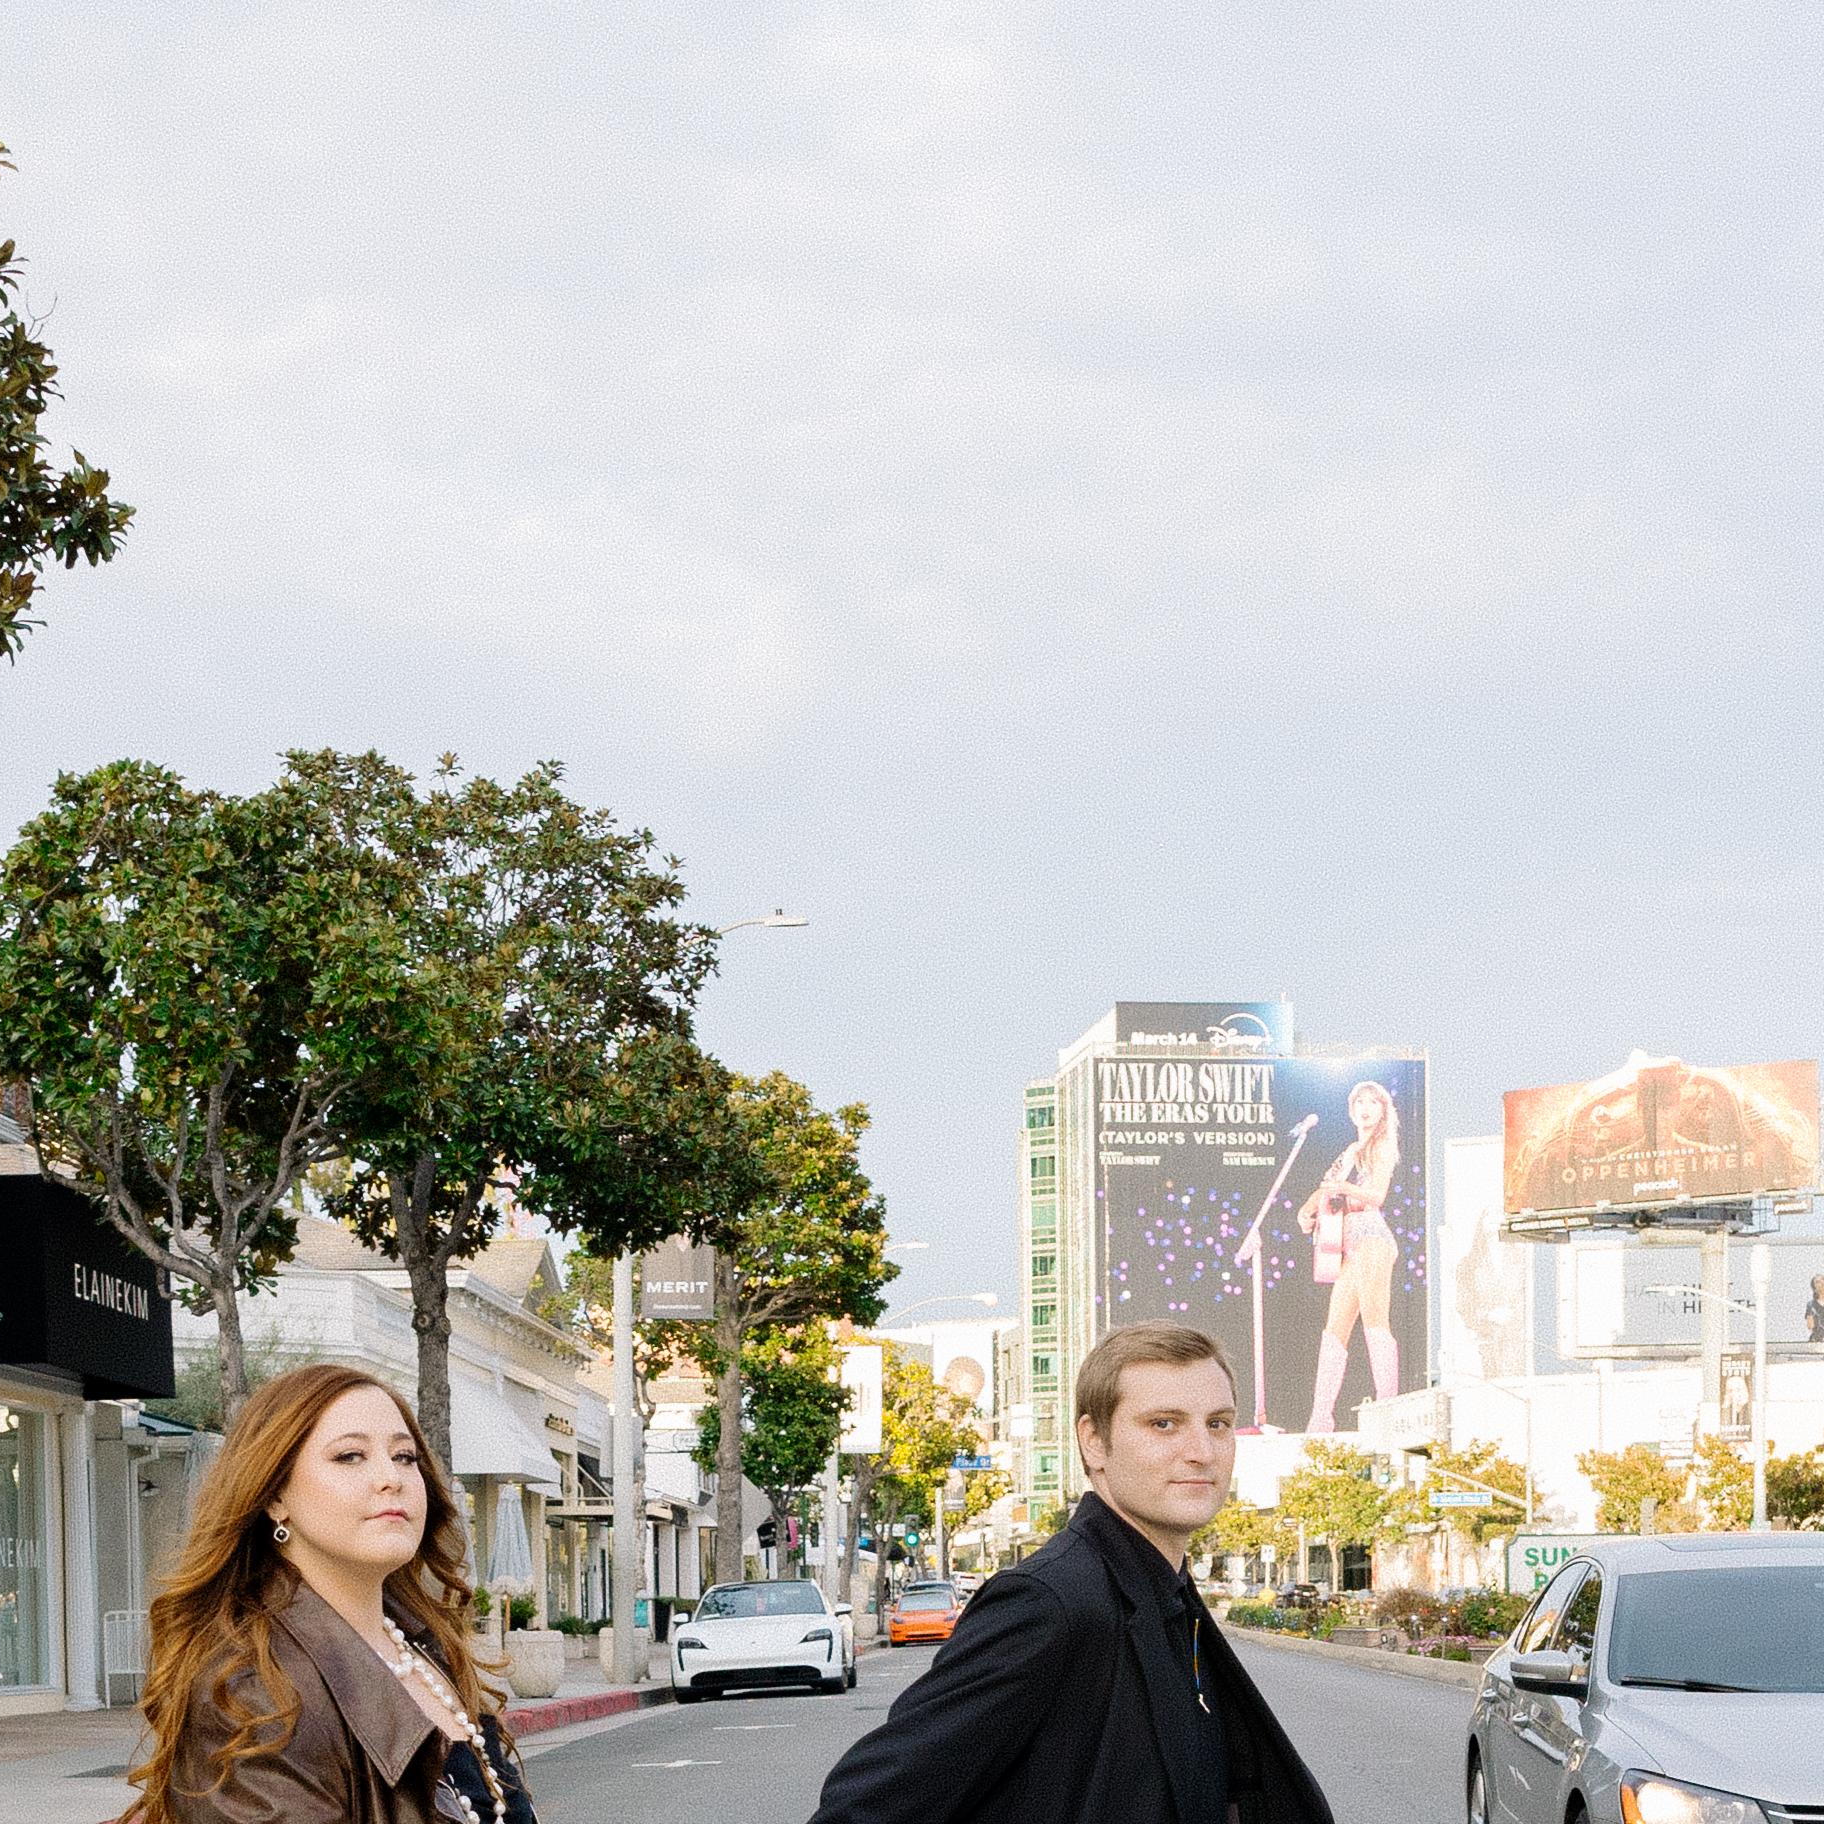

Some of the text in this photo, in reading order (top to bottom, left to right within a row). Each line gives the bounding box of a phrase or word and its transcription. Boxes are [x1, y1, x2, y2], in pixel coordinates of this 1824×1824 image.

[1130, 1031, 1178, 1046] March
[1098, 1062, 1275, 1104] TAYLOR SWIFT
[1099, 1103, 1275, 1124] THE ERAS TOUR
[1098, 1131, 1276, 1146] (TAYLOR'S VERSION)
[1561, 1151, 1756, 1184] OPPENHEIMER
[74, 1263, 149, 1321] ELAINEKIM
[646, 1281, 709, 1295] MERIT
[1525, 1547, 1577, 1566] SUN
